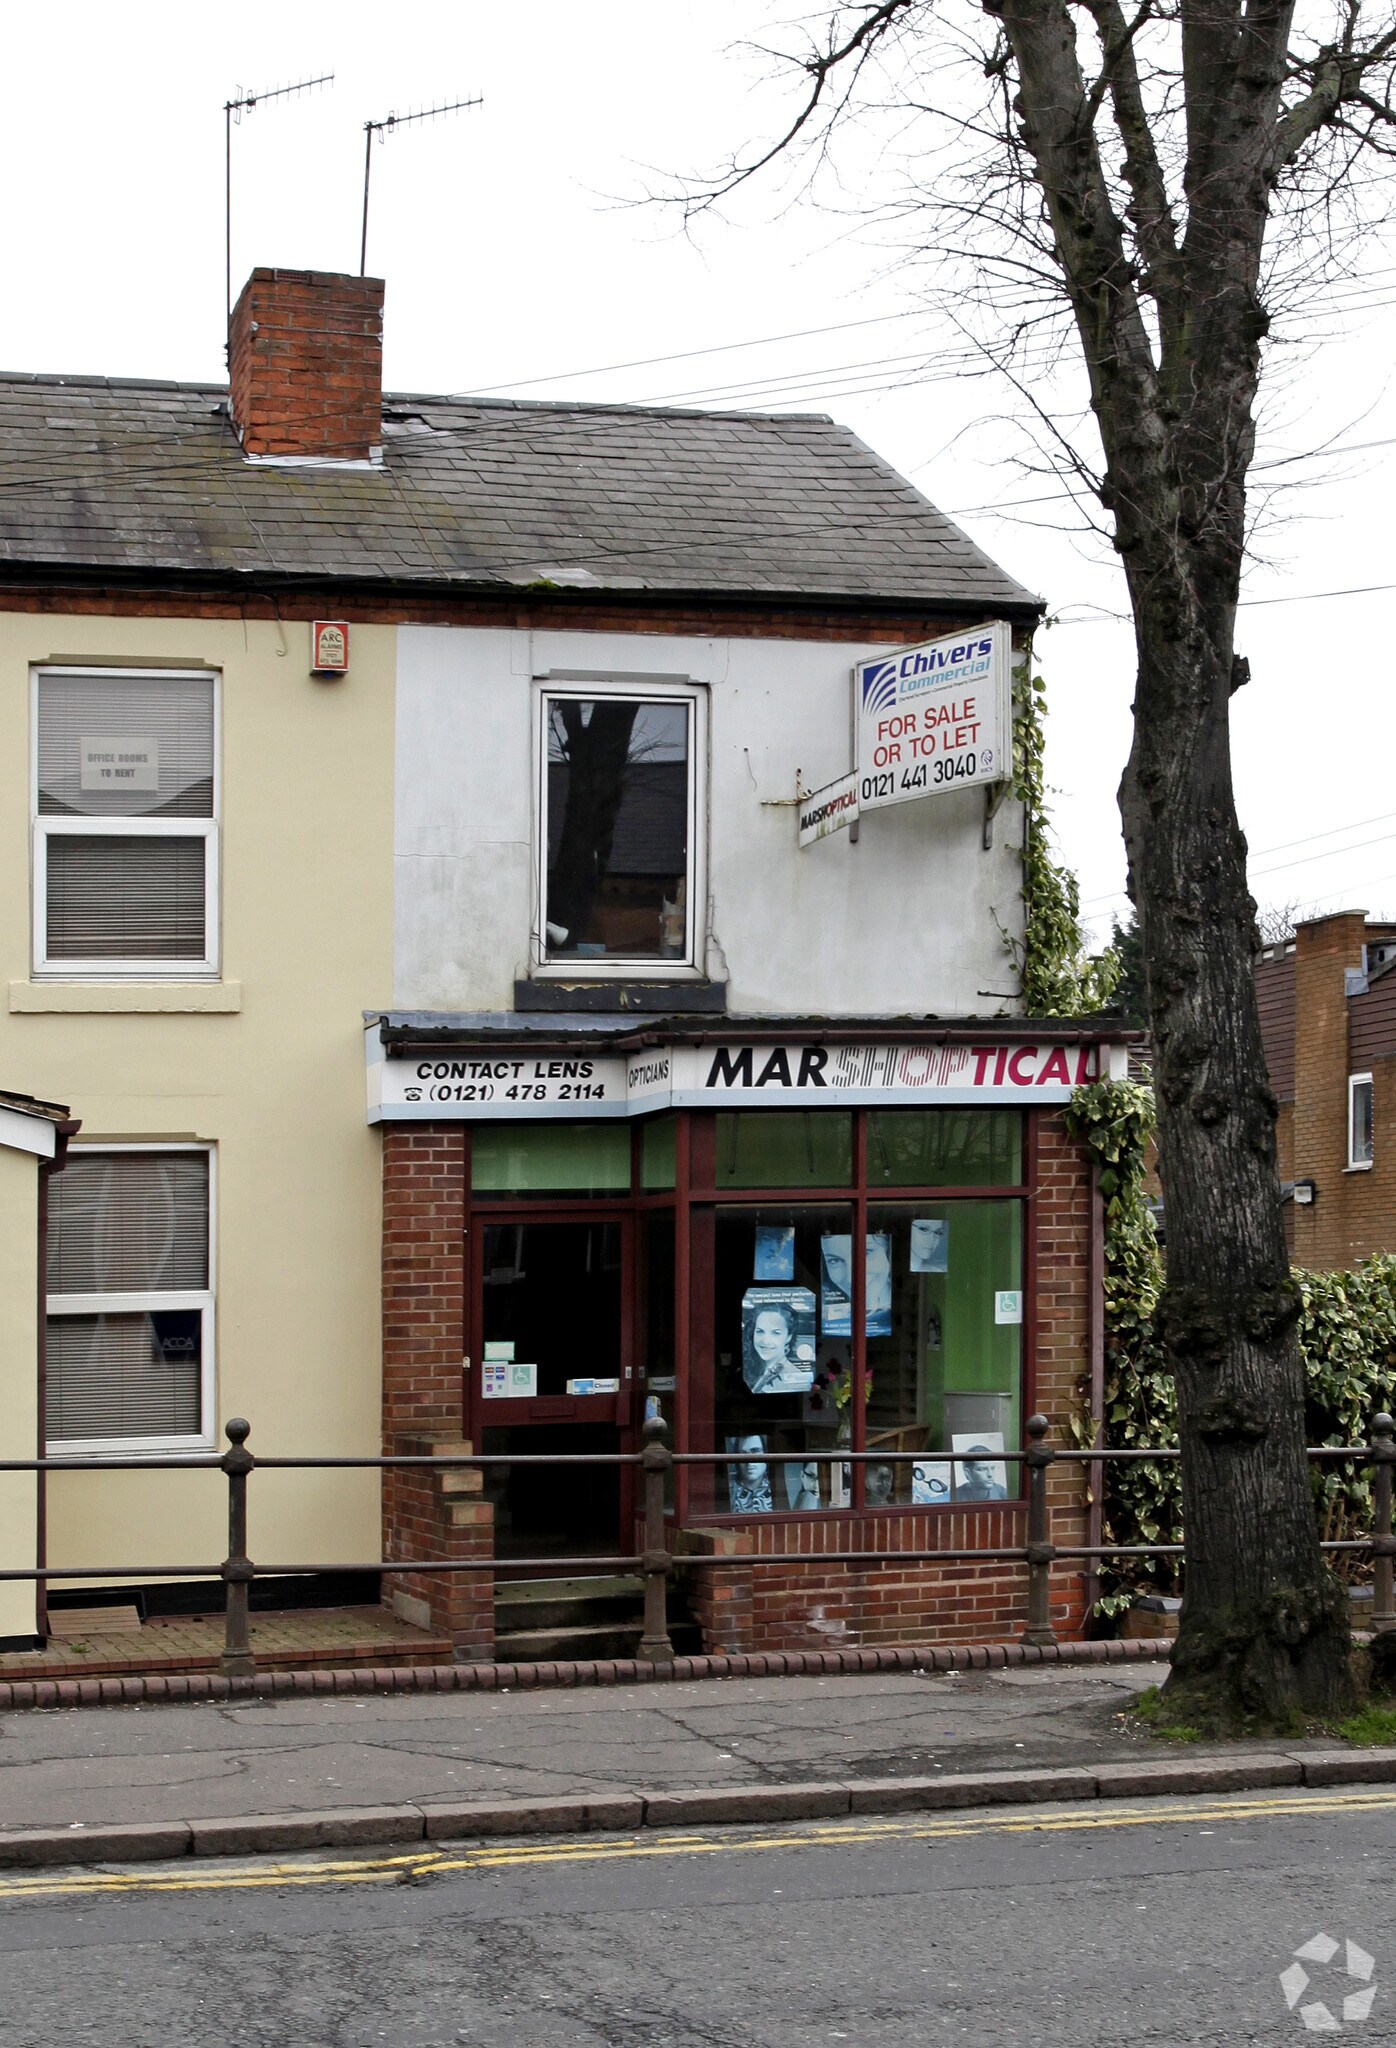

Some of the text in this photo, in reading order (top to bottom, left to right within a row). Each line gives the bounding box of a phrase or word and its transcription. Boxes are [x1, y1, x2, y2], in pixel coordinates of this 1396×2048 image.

[320, 633, 342, 642] ARC
[900, 638, 993, 678] Chivers
[899, 656, 991, 693] Commercial
[878, 697, 976, 741] FOR SALE
[87, 753, 149, 763] OFFICE ROOMS
[873, 722, 981, 767] OR TO LET
[100, 768, 135, 777] TO RENT
[862, 752, 976, 799] 0121 441 3040
[800, 789, 857, 831] MARSHOPTICAL
[416, 1061, 593, 1079] CONTACT LENS
[629, 1059, 669, 1088] OPTICIANS
[429, 1084, 605, 1101] (0121) 478 2114
[162, 1337, 195, 1349] ACCA
